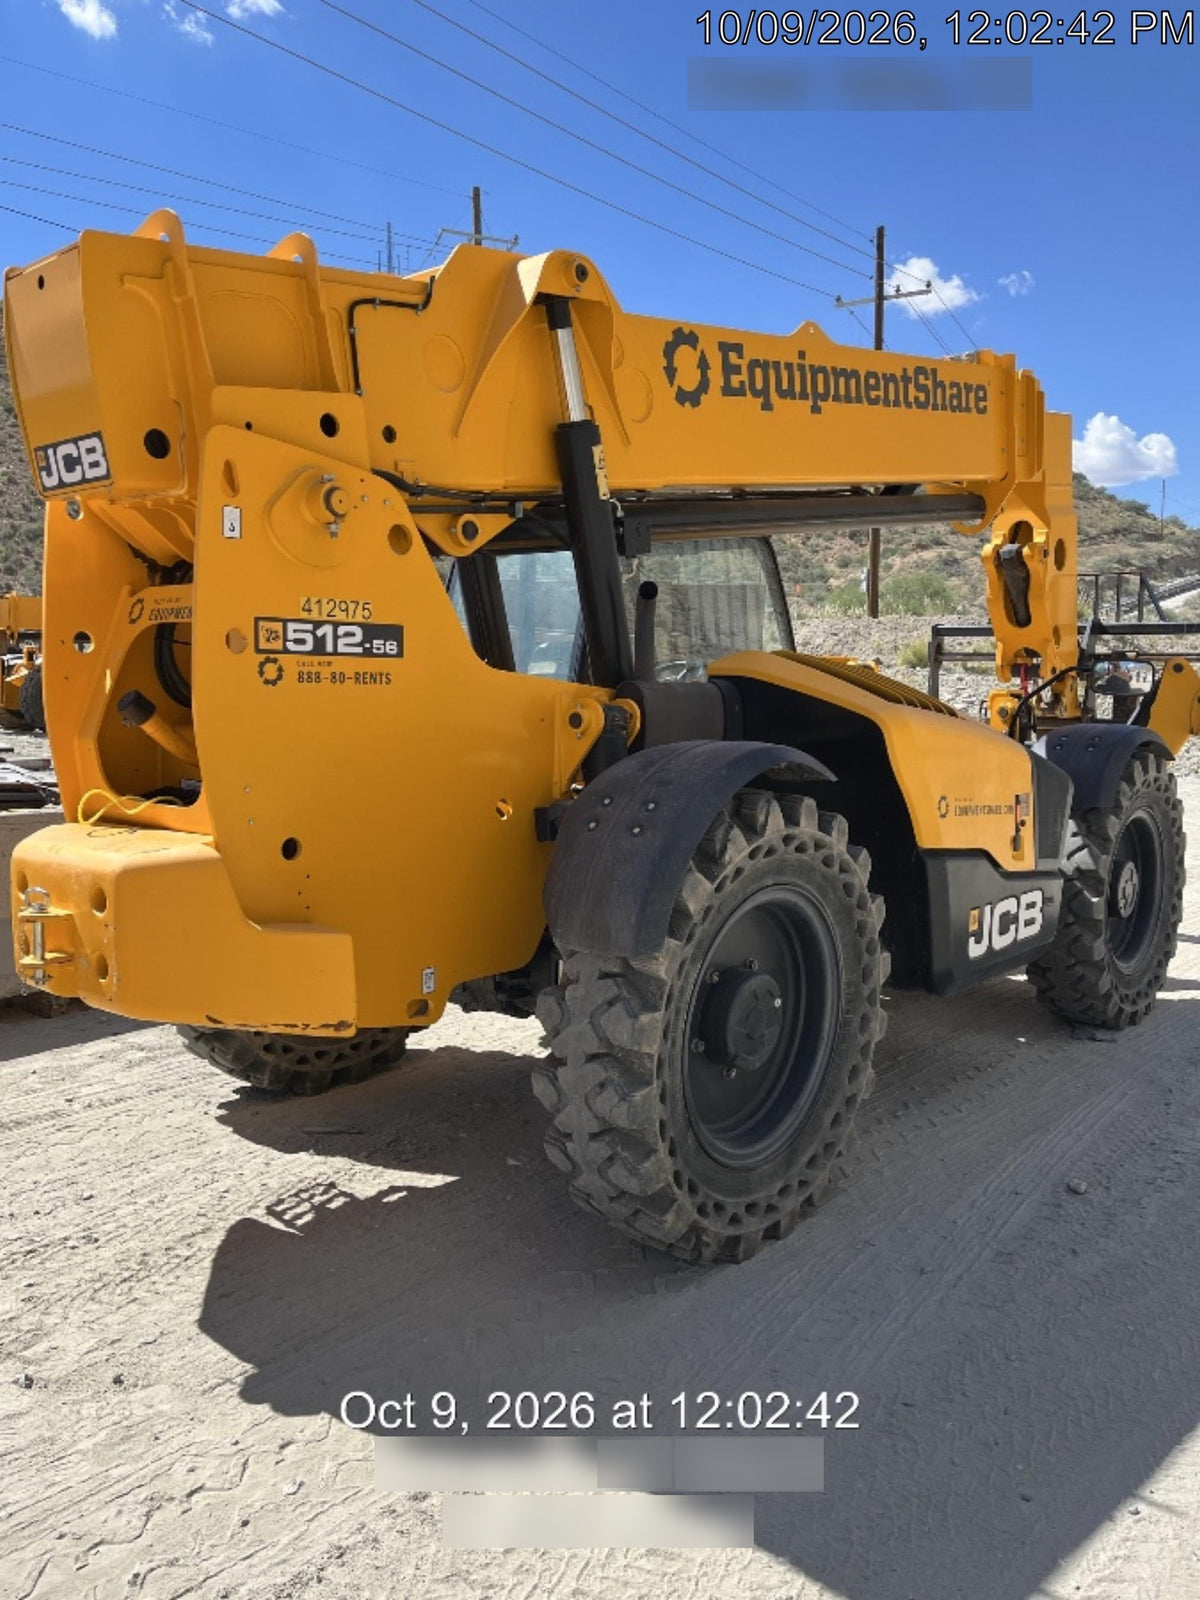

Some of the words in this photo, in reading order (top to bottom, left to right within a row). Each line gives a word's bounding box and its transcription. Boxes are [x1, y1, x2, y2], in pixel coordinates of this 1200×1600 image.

[718, 341, 988, 415] EquipmentShare
[40, 437, 108, 488] JCB
[301, 597, 373, 621] 412975
[297, 671, 392, 685] 888-80-RENTS
[968, 890, 1043, 960] JCB
